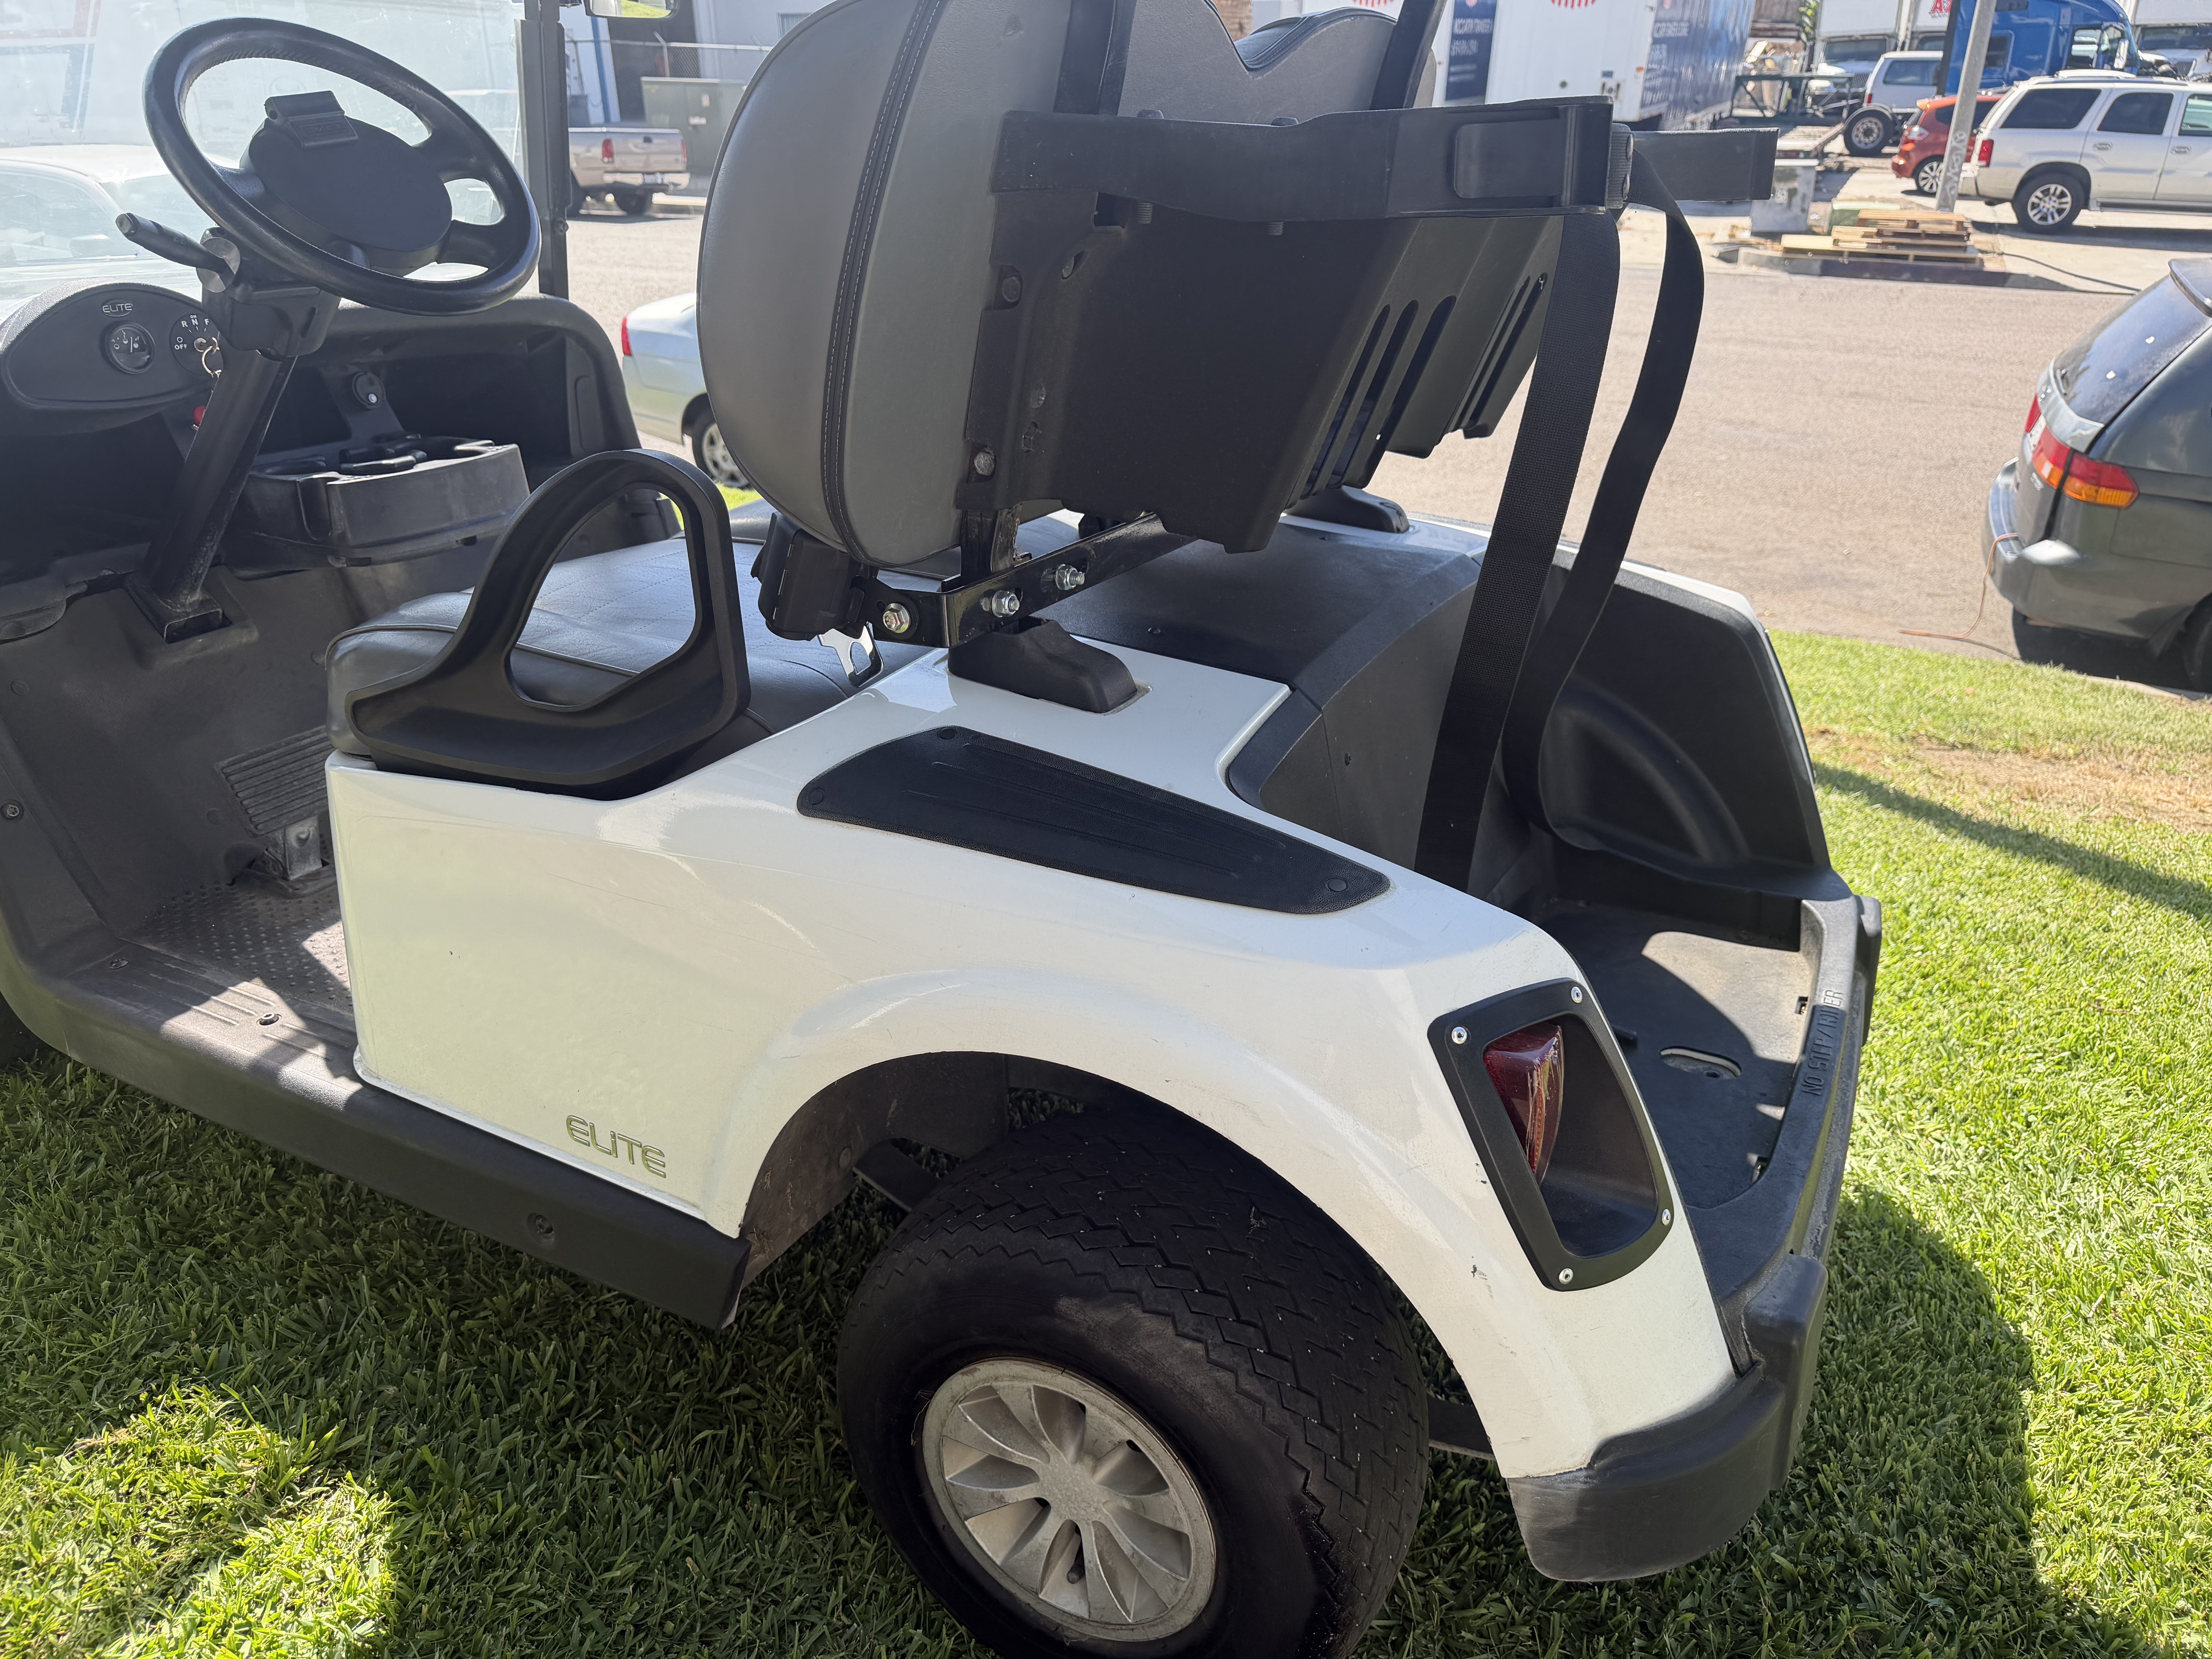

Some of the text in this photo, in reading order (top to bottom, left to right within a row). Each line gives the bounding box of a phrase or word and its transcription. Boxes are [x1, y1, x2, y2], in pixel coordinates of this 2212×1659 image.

[103, 303, 132, 313] ELITE
[1801, 1076, 1824, 1096] NO
[566, 1115, 666, 1178] ELITE
